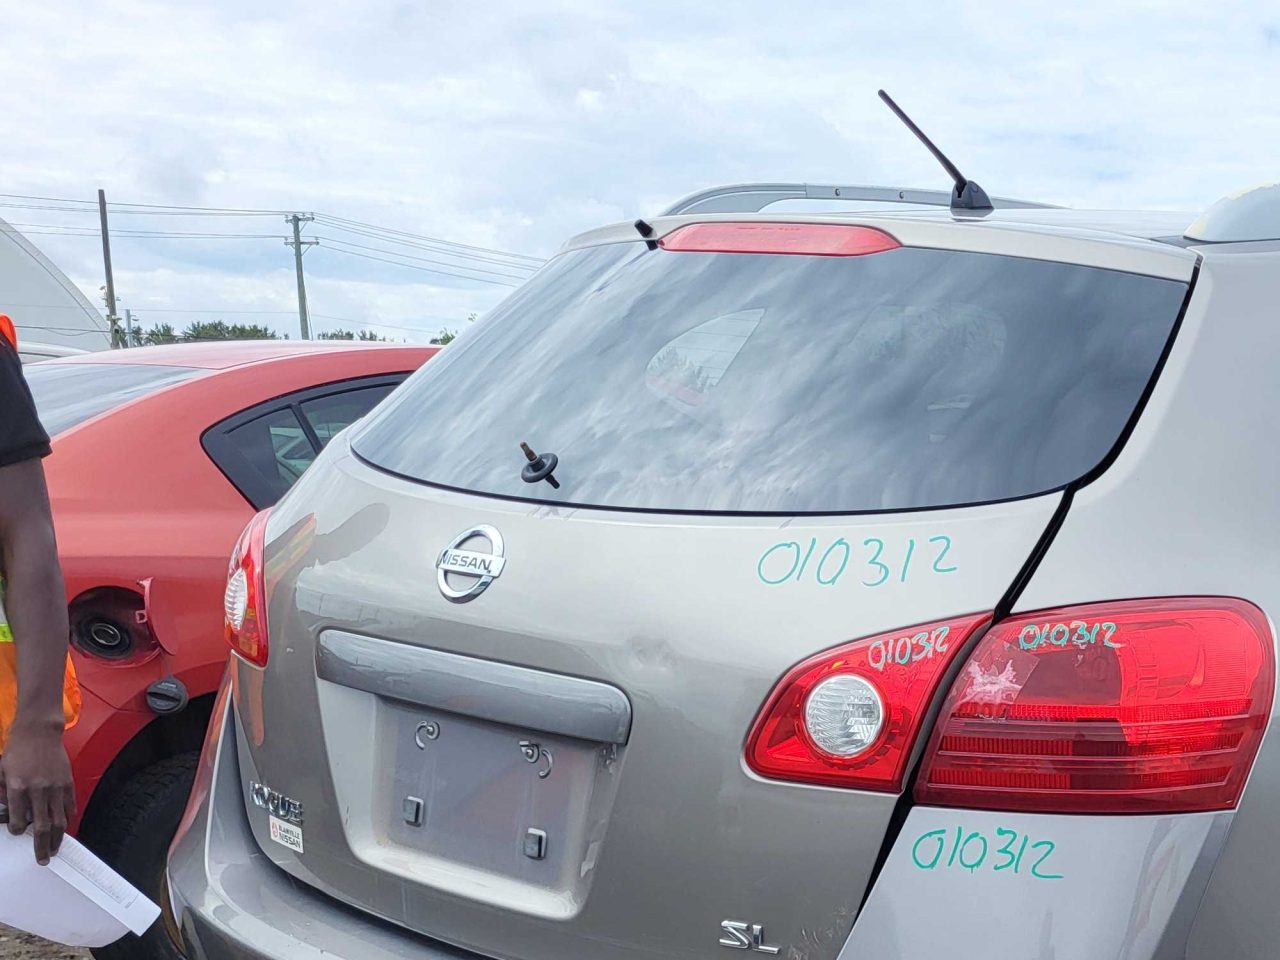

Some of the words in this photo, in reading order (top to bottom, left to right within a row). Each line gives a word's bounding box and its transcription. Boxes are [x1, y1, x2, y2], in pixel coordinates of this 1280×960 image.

[440, 551, 492, 572] NISSAN
[757, 534, 959, 587] 010312
[868, 625, 950, 672] 010312
[1018, 621, 1126, 649] 010312
[911, 827, 1065, 881] 010312
[719, 919, 780, 954] SL
